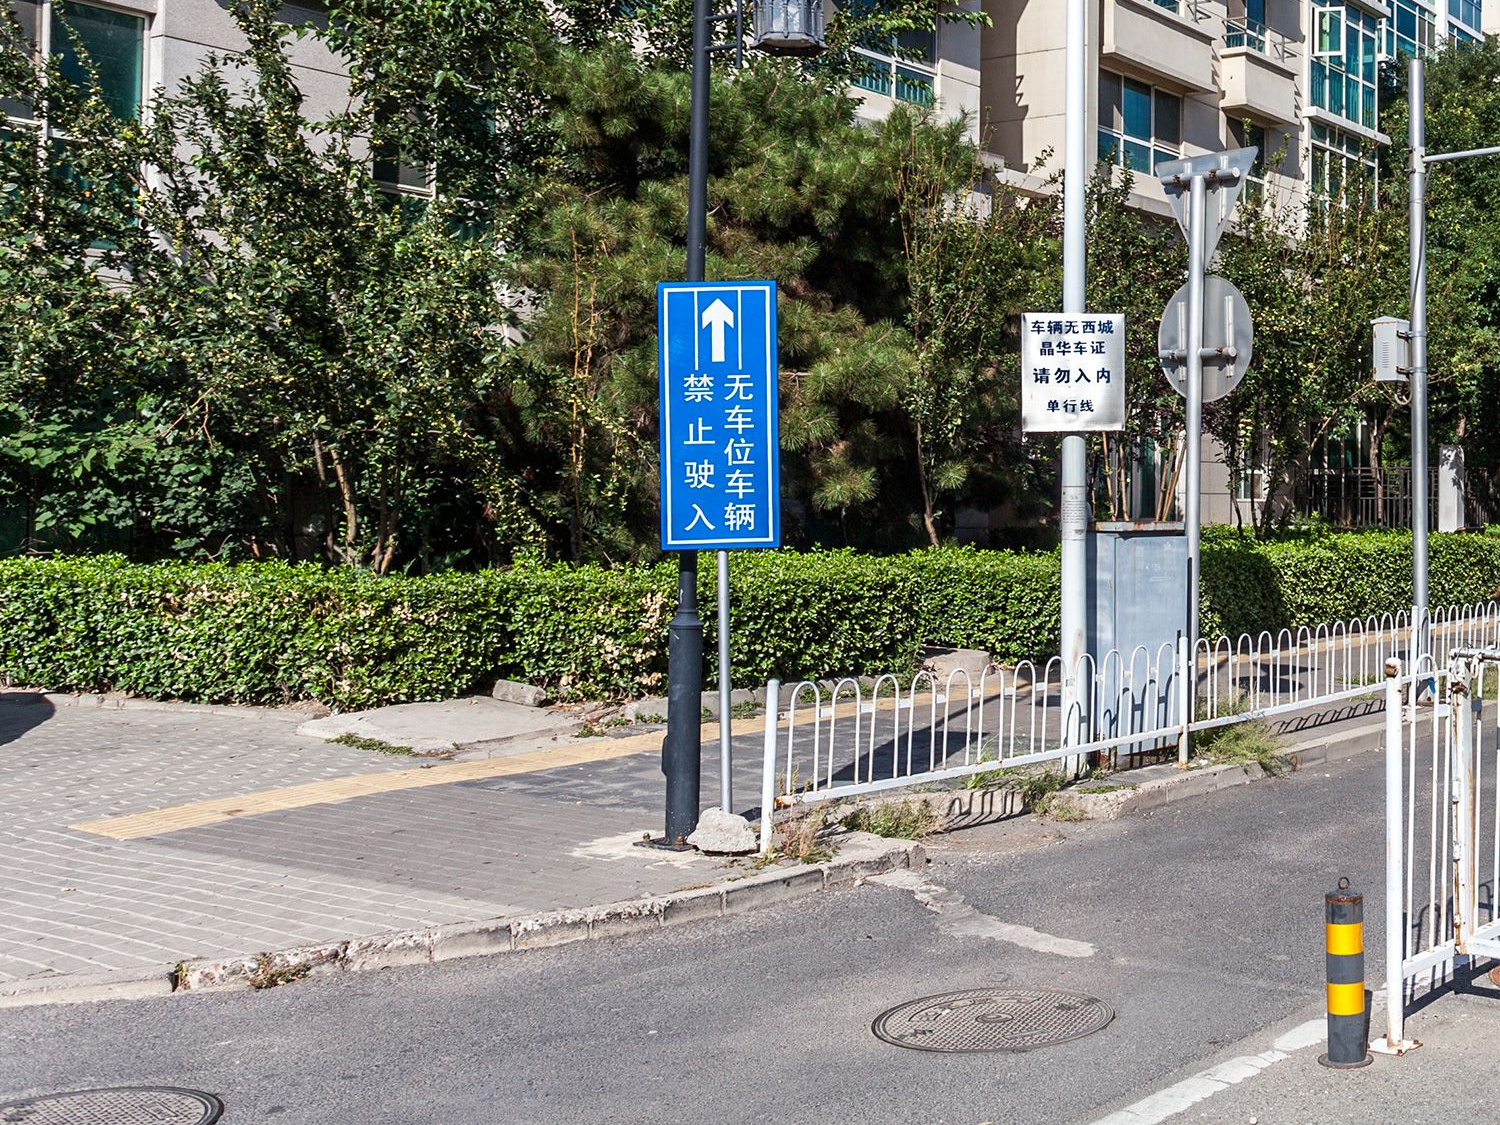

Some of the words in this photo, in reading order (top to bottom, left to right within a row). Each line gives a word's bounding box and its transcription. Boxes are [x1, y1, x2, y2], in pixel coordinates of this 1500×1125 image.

[1031, 320, 1114, 334] 车辆无西城
[1040, 341, 1106, 356] 晶华车证
[1033, 368, 1111, 384] 请勿入内
[1047, 400, 1094, 413] 单行线
[684, 373, 716, 531] 禁止驶入
[724, 374, 756, 531] 无车位车辆
